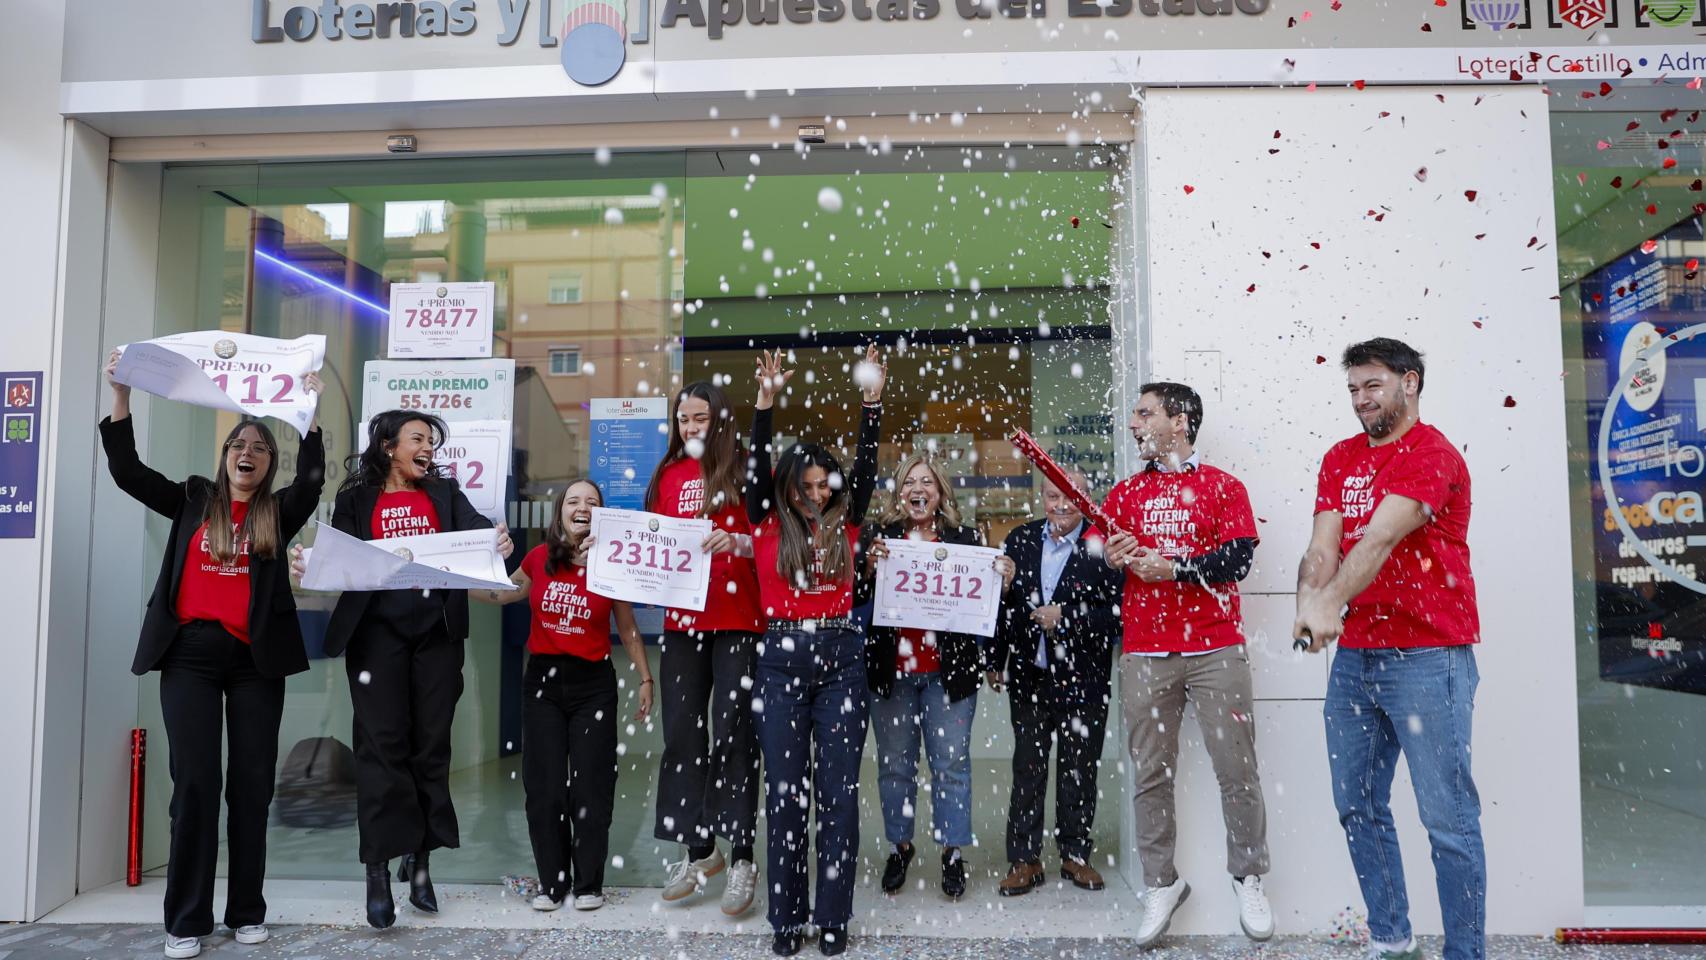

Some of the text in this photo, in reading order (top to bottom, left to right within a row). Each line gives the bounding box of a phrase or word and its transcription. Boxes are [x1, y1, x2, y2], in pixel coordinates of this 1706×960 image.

[496, 0, 530, 46] y
[1458, 54, 1538, 74] Lotería
[1546, 53, 1632, 74] Castillo
[427, 298, 466, 308] PREMIO
[405, 308, 479, 328] 78477
[387, 377, 489, 391] GRAN PREMIO
[399, 393, 473, 409] 55.726€
[432, 446, 467, 459] EMIO
[9, 486, 18, 498] y
[15, 501, 33, 513] del
[1144, 497, 1175, 510] #SOY
[381, 505, 412, 519] #SOY
[1143, 509, 1190, 523] LOTERIA
[381, 515, 430, 531] LOTERIA
[1143, 522, 1196, 536] CASTILLO
[638, 531, 678, 547] PREMIO
[607, 539, 693, 573] 23112
[924, 561, 969, 575] PRIO
[547, 580, 577, 594] #SOY
[894, 570, 983, 600] 23112
[542, 589, 588, 608] LOTERIA
[541, 600, 592, 620] CASTILLO
